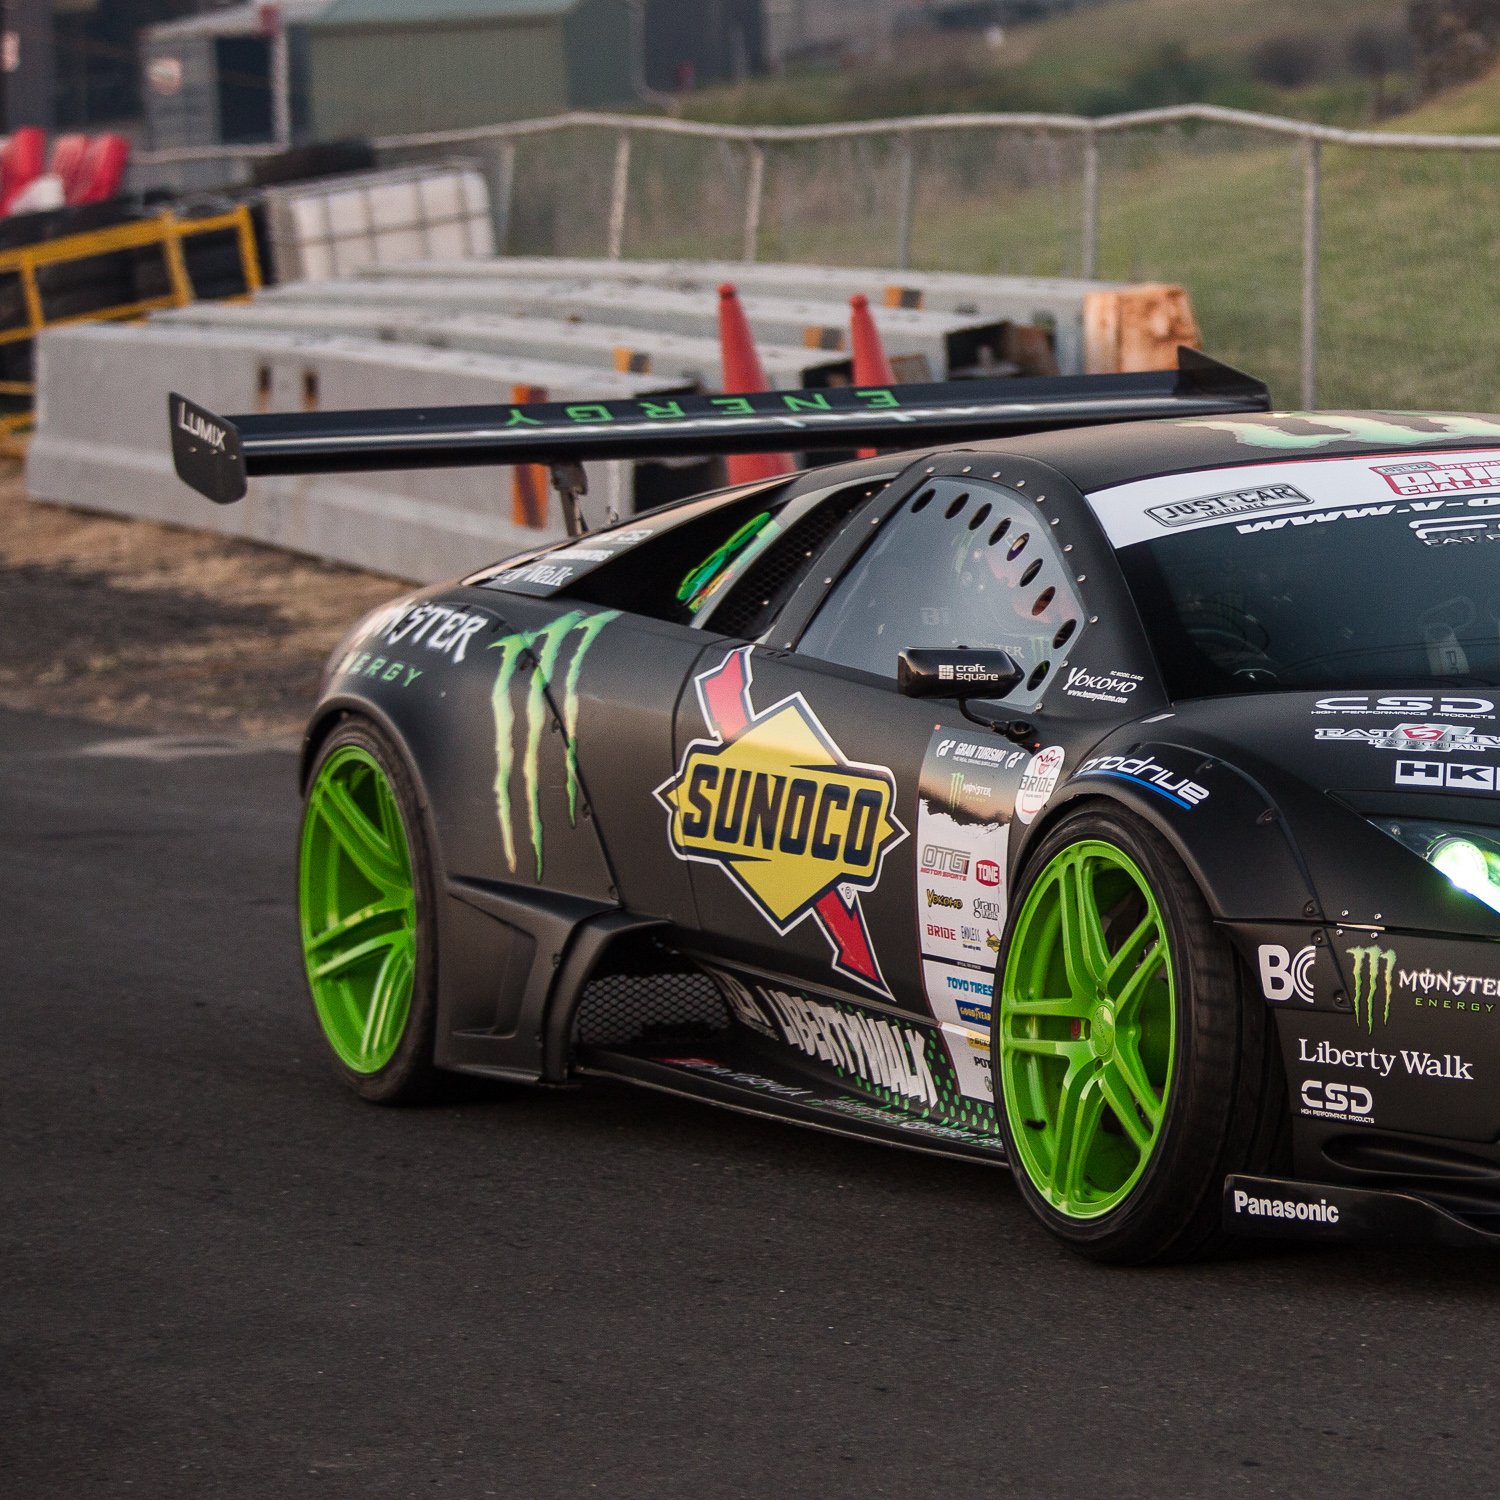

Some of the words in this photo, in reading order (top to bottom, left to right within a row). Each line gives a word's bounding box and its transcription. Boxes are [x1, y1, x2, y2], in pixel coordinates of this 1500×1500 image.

[504, 390, 903, 427] ENERGY
[178, 401, 226, 452] LUMIX
[1205, 502, 1268, 517] INSURANCE
[1424, 535, 1477, 546] FAT
[524, 564, 574, 587] Walk
[956, 664, 986, 673] craft
[956, 672, 999, 682] square
[1062, 667, 1137, 693] YOKOMO
[1315, 697, 1494, 714] CSD
[1433, 712, 1496, 720] PRODUCTS
[1316, 727, 1396, 741] FAT
[955, 743, 978, 757] GRAN
[974, 746, 1006, 762] TURISMO
[1019, 774, 1056, 793] BRIDE
[682, 763, 883, 867] SUNOCO
[921, 867, 944, 878] MOTOR
[942, 872, 967, 881] SPORTS
[977, 863, 999, 883] TONE
[973, 898, 1000, 918] gram
[926, 924, 957, 941] BRIDE
[1258, 944, 1316, 1004] BC
[946, 976, 969, 992] TOYO
[970, 981, 993, 997] TIRES
[1415, 997, 1496, 1012] ENERGY
[756, 985, 938, 1109] LIBERTYWALK
[1298, 1038, 1396, 1077] Liberty
[1400, 1050, 1474, 1080] Walk
[1301, 1079, 1373, 1114] CSD
[1313, 1110, 1348, 1120] PERFORMANCE
[1349, 1115, 1375, 1124] PRODUCTS
[1234, 1190, 1339, 1223] Panasonic
